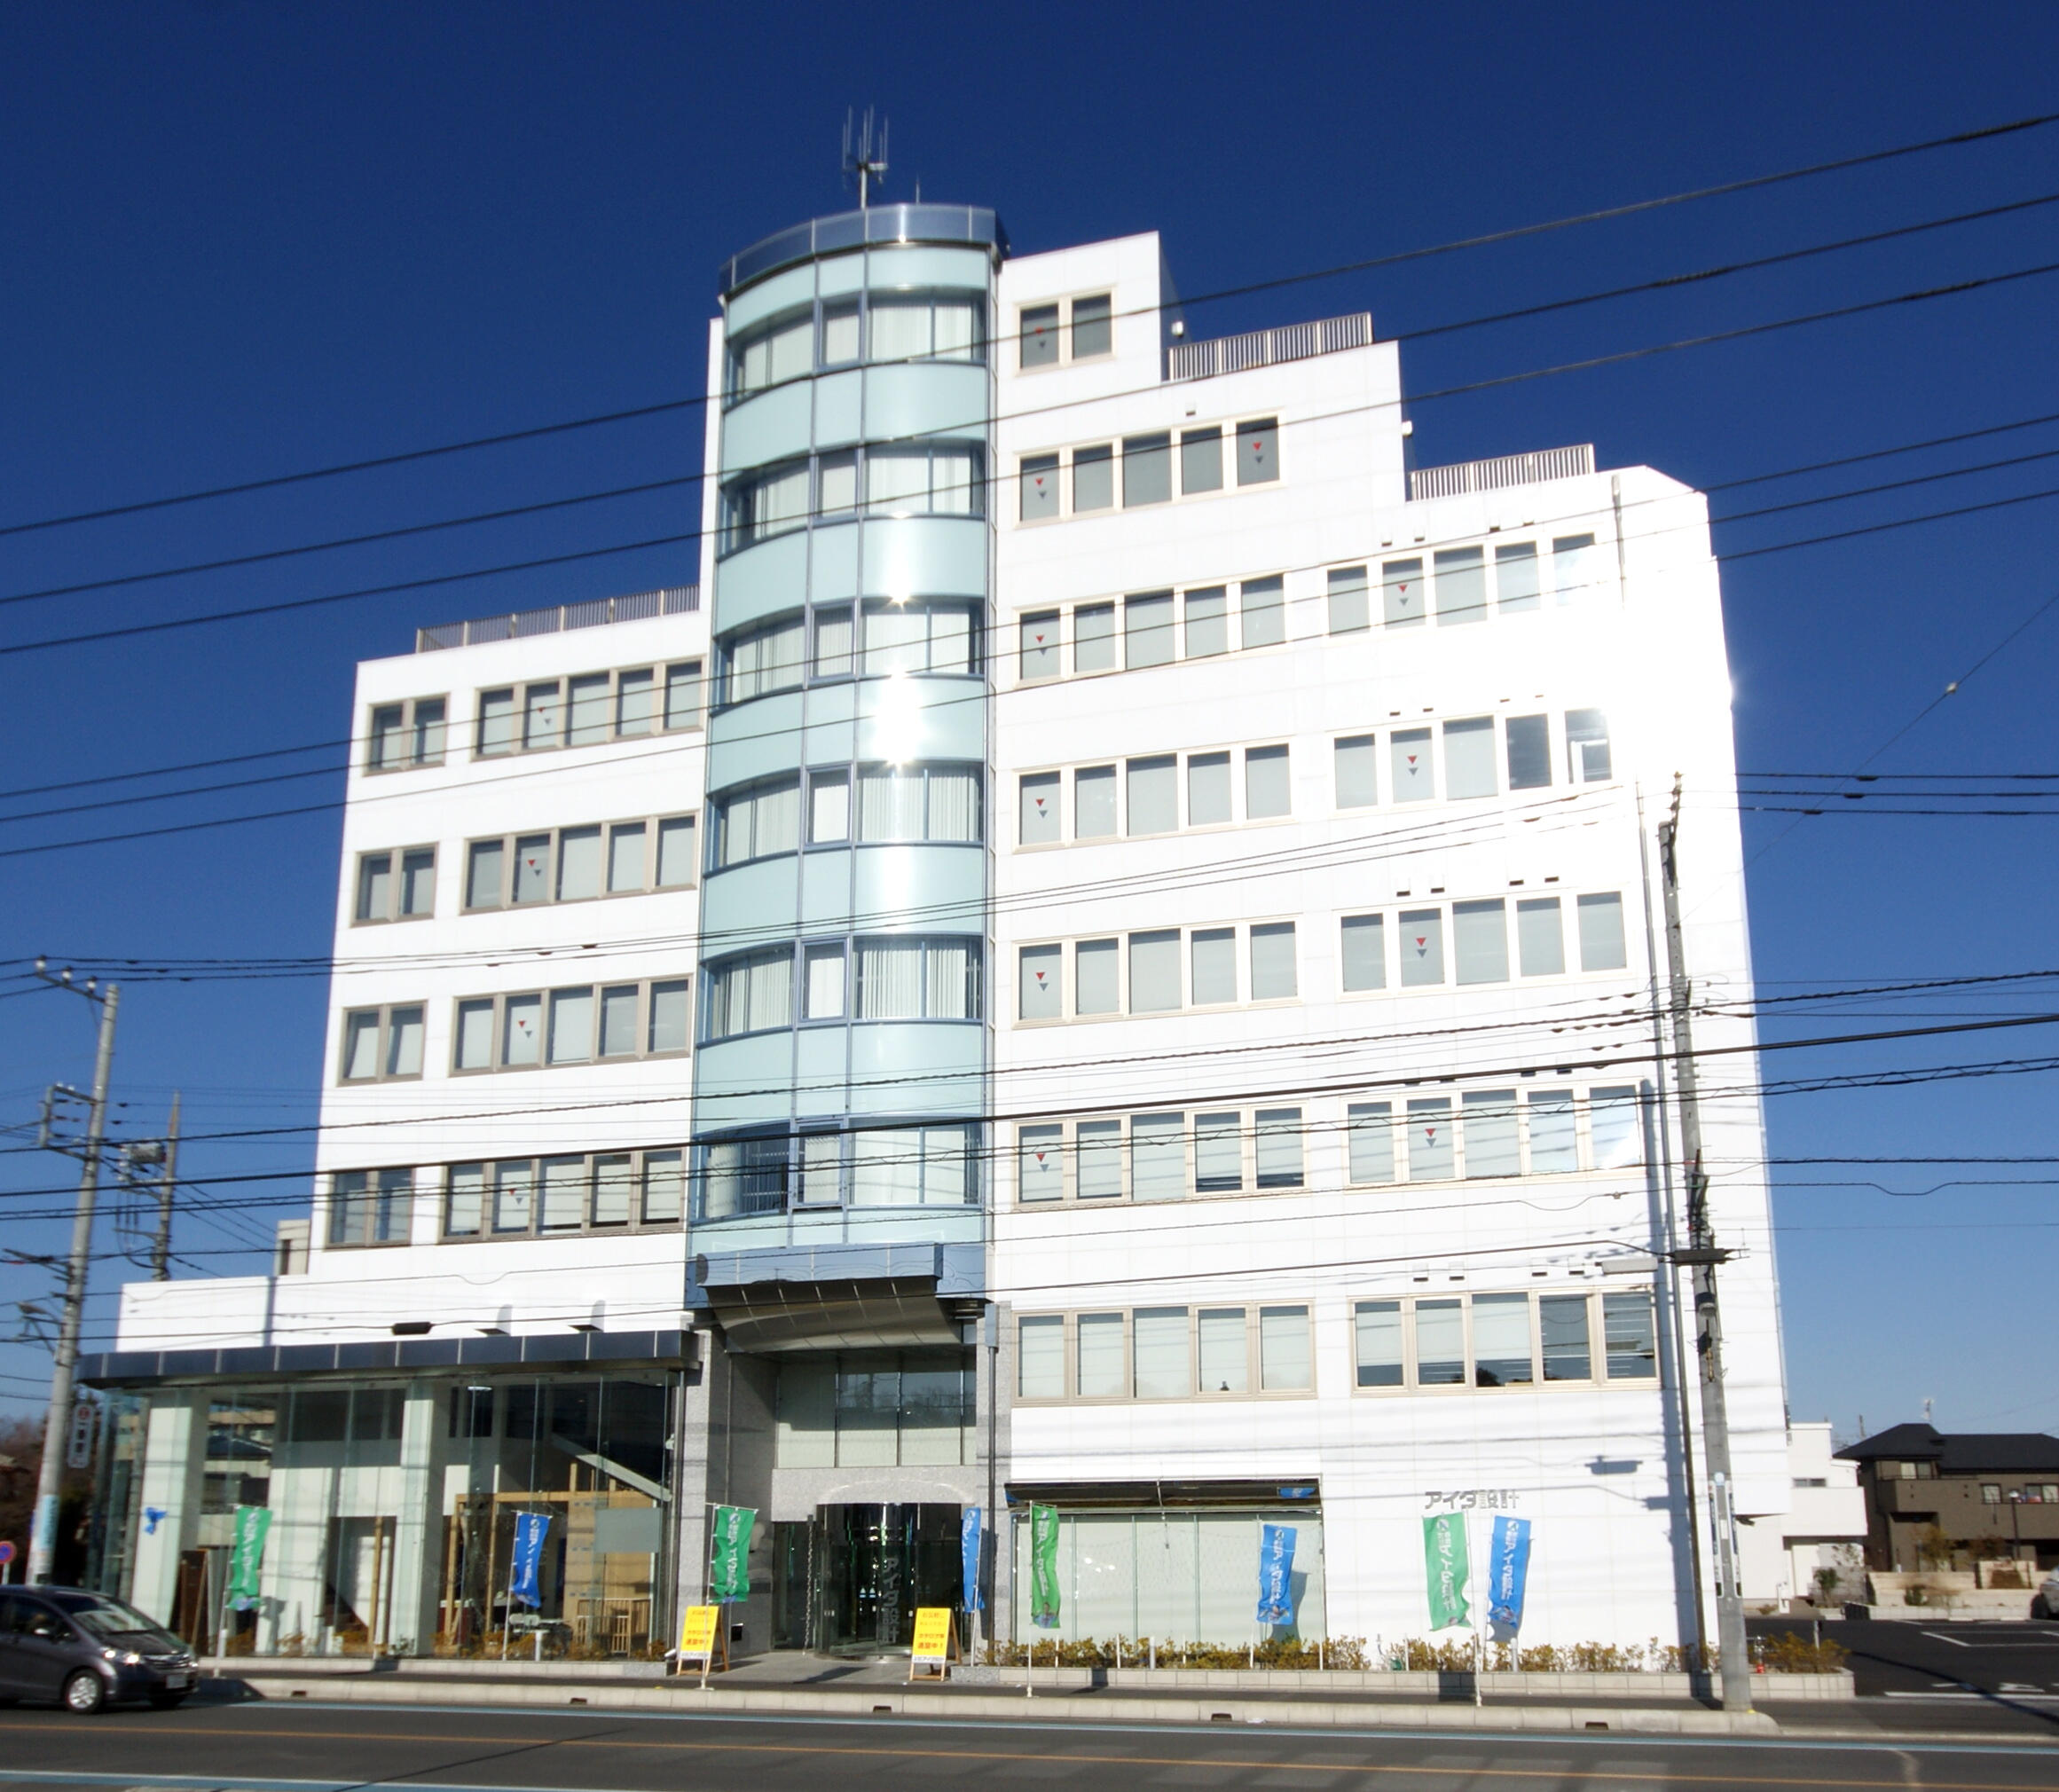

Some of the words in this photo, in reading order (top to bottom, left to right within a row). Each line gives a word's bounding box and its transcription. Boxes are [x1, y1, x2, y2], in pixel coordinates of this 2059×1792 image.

[1425, 1489, 1519, 1510] アイダ設計
[880, 1557, 900, 1645] アイダ設計
